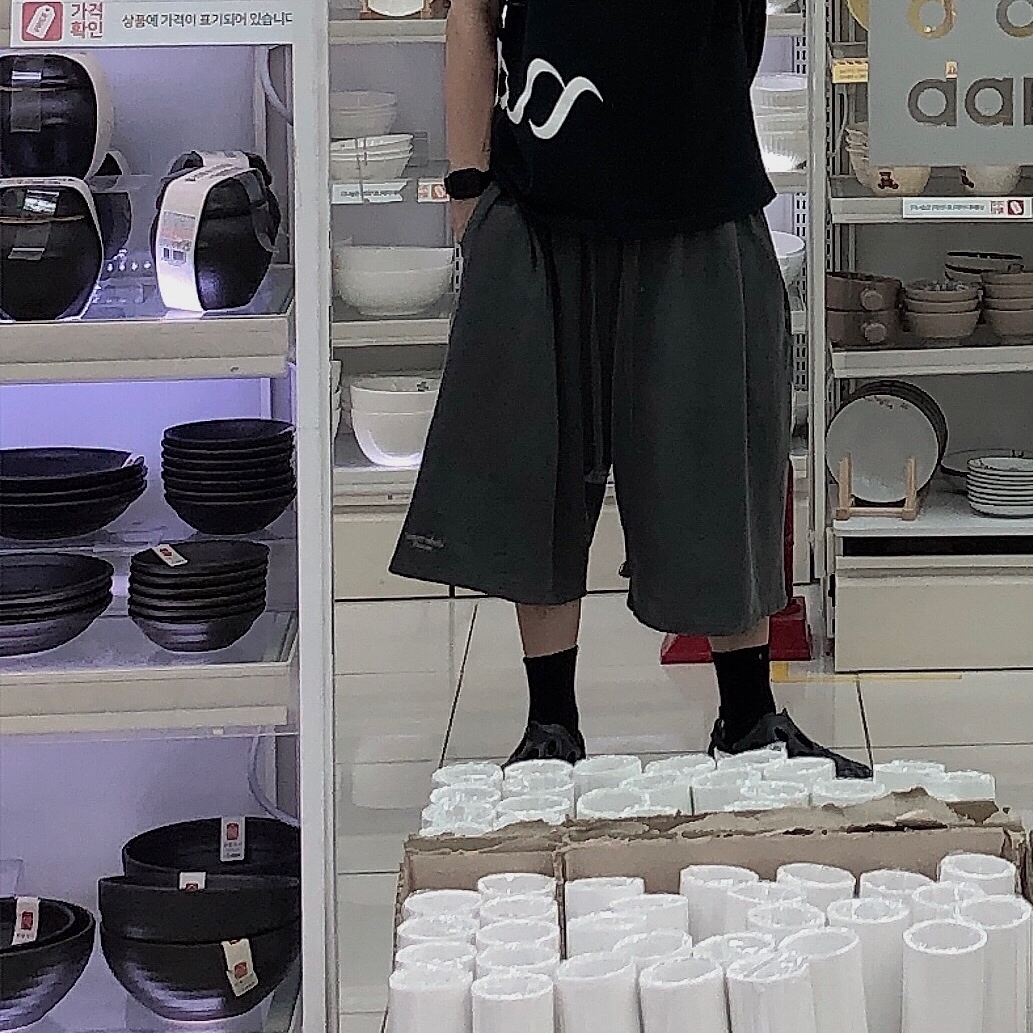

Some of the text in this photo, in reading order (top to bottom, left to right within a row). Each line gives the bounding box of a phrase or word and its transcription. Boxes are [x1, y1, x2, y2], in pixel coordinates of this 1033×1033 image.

[70, 2, 104, 20] 가격
[160, 13, 197, 28] 가격이
[70, 21, 104, 39] 확인
